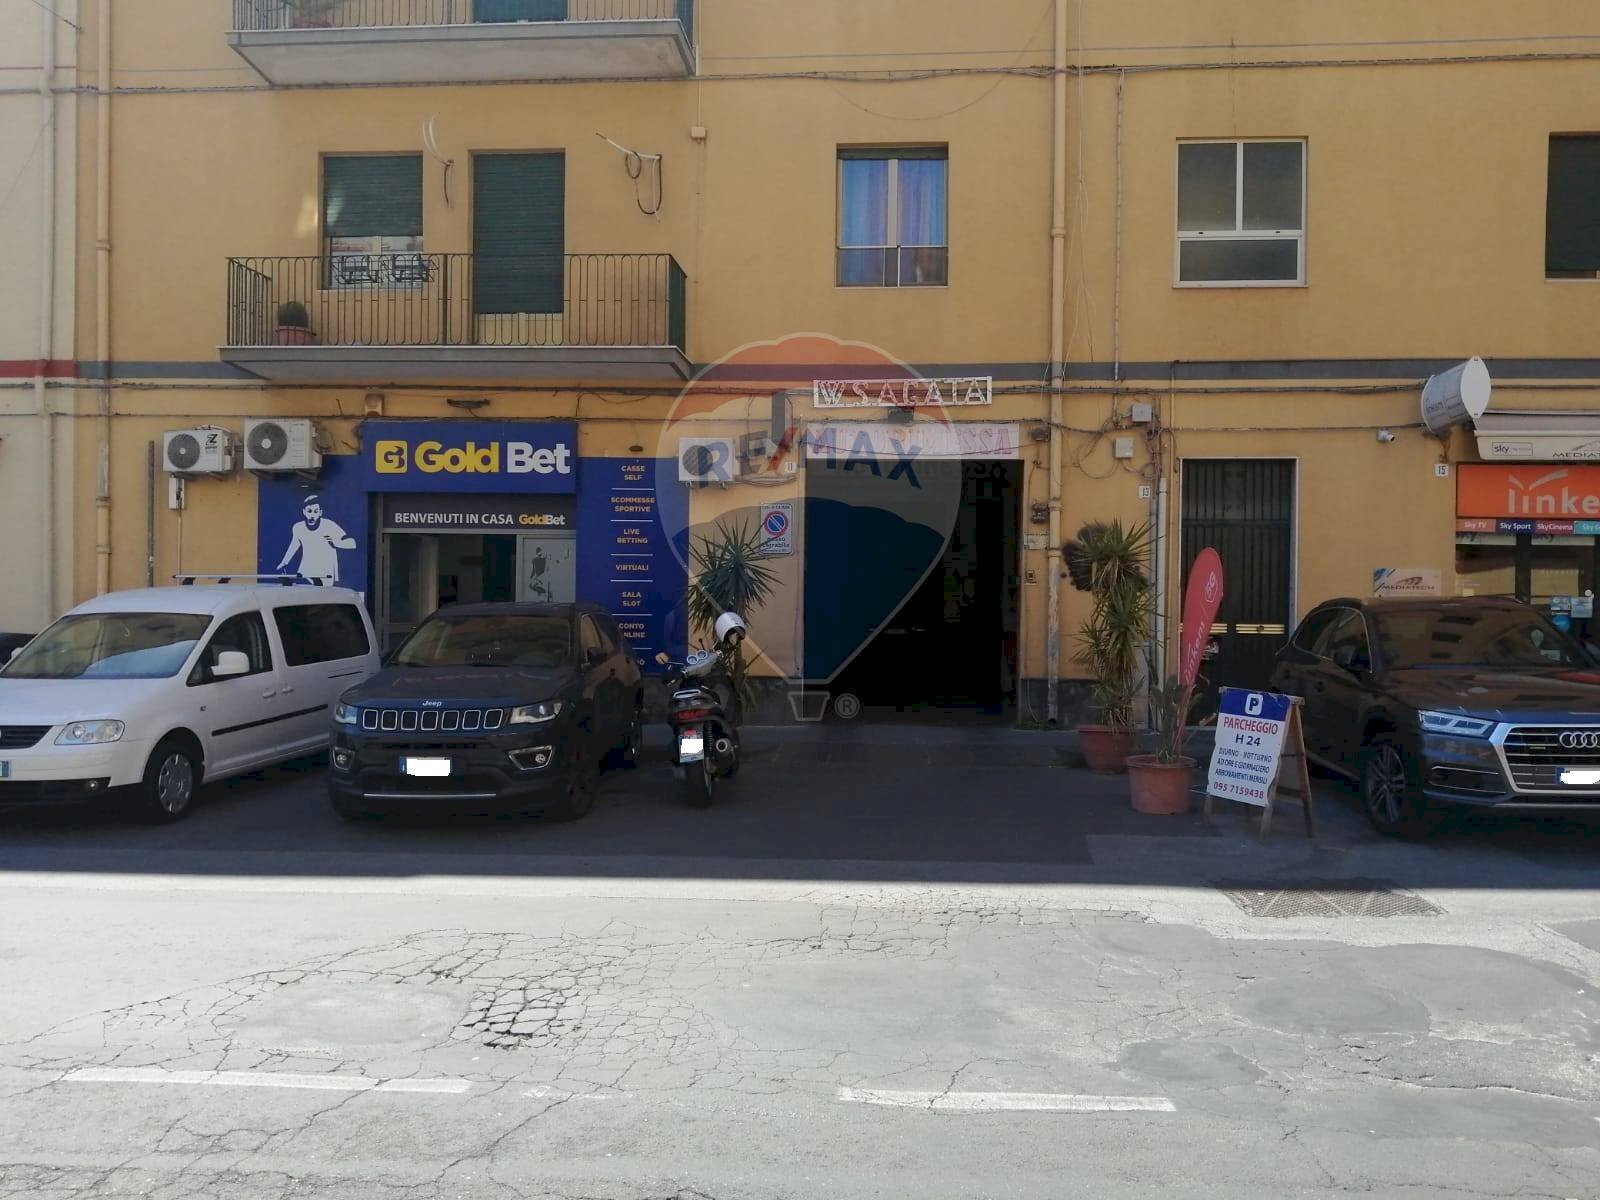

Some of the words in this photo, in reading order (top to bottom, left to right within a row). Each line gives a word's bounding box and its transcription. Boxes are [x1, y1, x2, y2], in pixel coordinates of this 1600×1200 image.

[414, 441, 499, 473] Gold
[507, 442, 571, 474] Bet
[395, 512, 465, 525] BENVENUTI
[466, 513, 479, 525] IN
[481, 513, 514, 525] CASA
[518, 514, 566, 526] GoldBet
[1500, 522, 1512, 530] Sky
[1513, 522, 1531, 531] Sport
[422, 700, 442, 708] Jeep
[1249, 697, 1260, 712] P
[1224, 716, 1278, 734] PARCHEGGIO
[1235, 733, 1244, 744] H
[1246, 735, 1261, 747] 24
